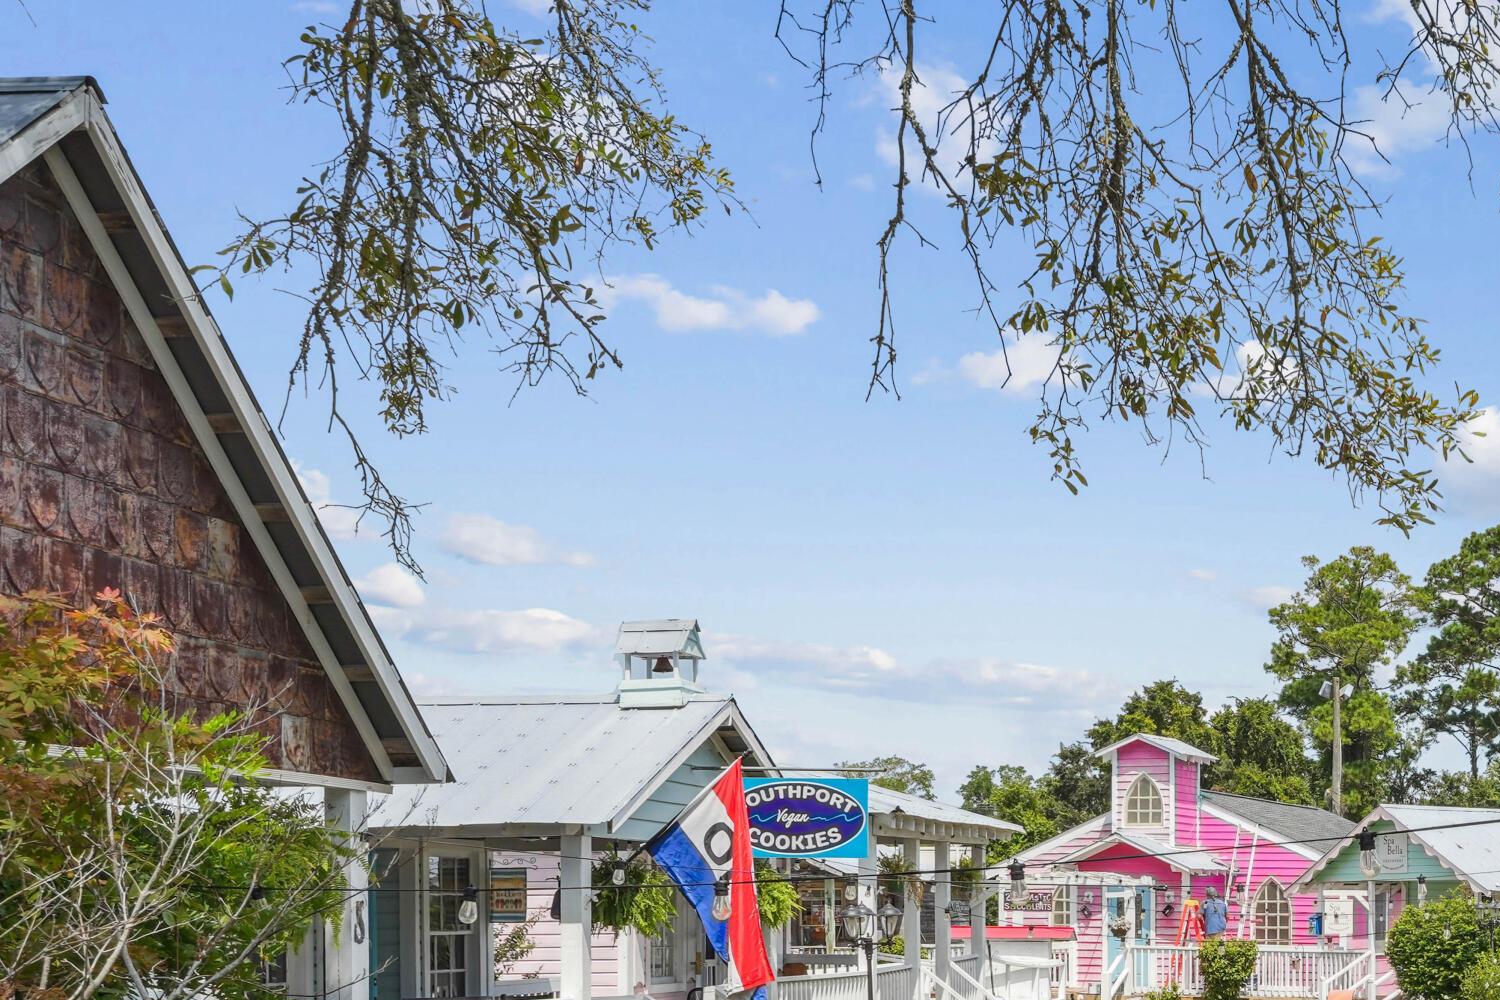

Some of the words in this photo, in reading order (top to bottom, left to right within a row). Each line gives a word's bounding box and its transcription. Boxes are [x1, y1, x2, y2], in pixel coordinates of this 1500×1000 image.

[745, 785, 858, 813] OUTHPORT
[776, 808, 810, 829] Vegan
[749, 827, 842, 850] COOKIES
[1384, 835, 1395, 847] Spa
[1388, 845, 1403, 855] Bella
